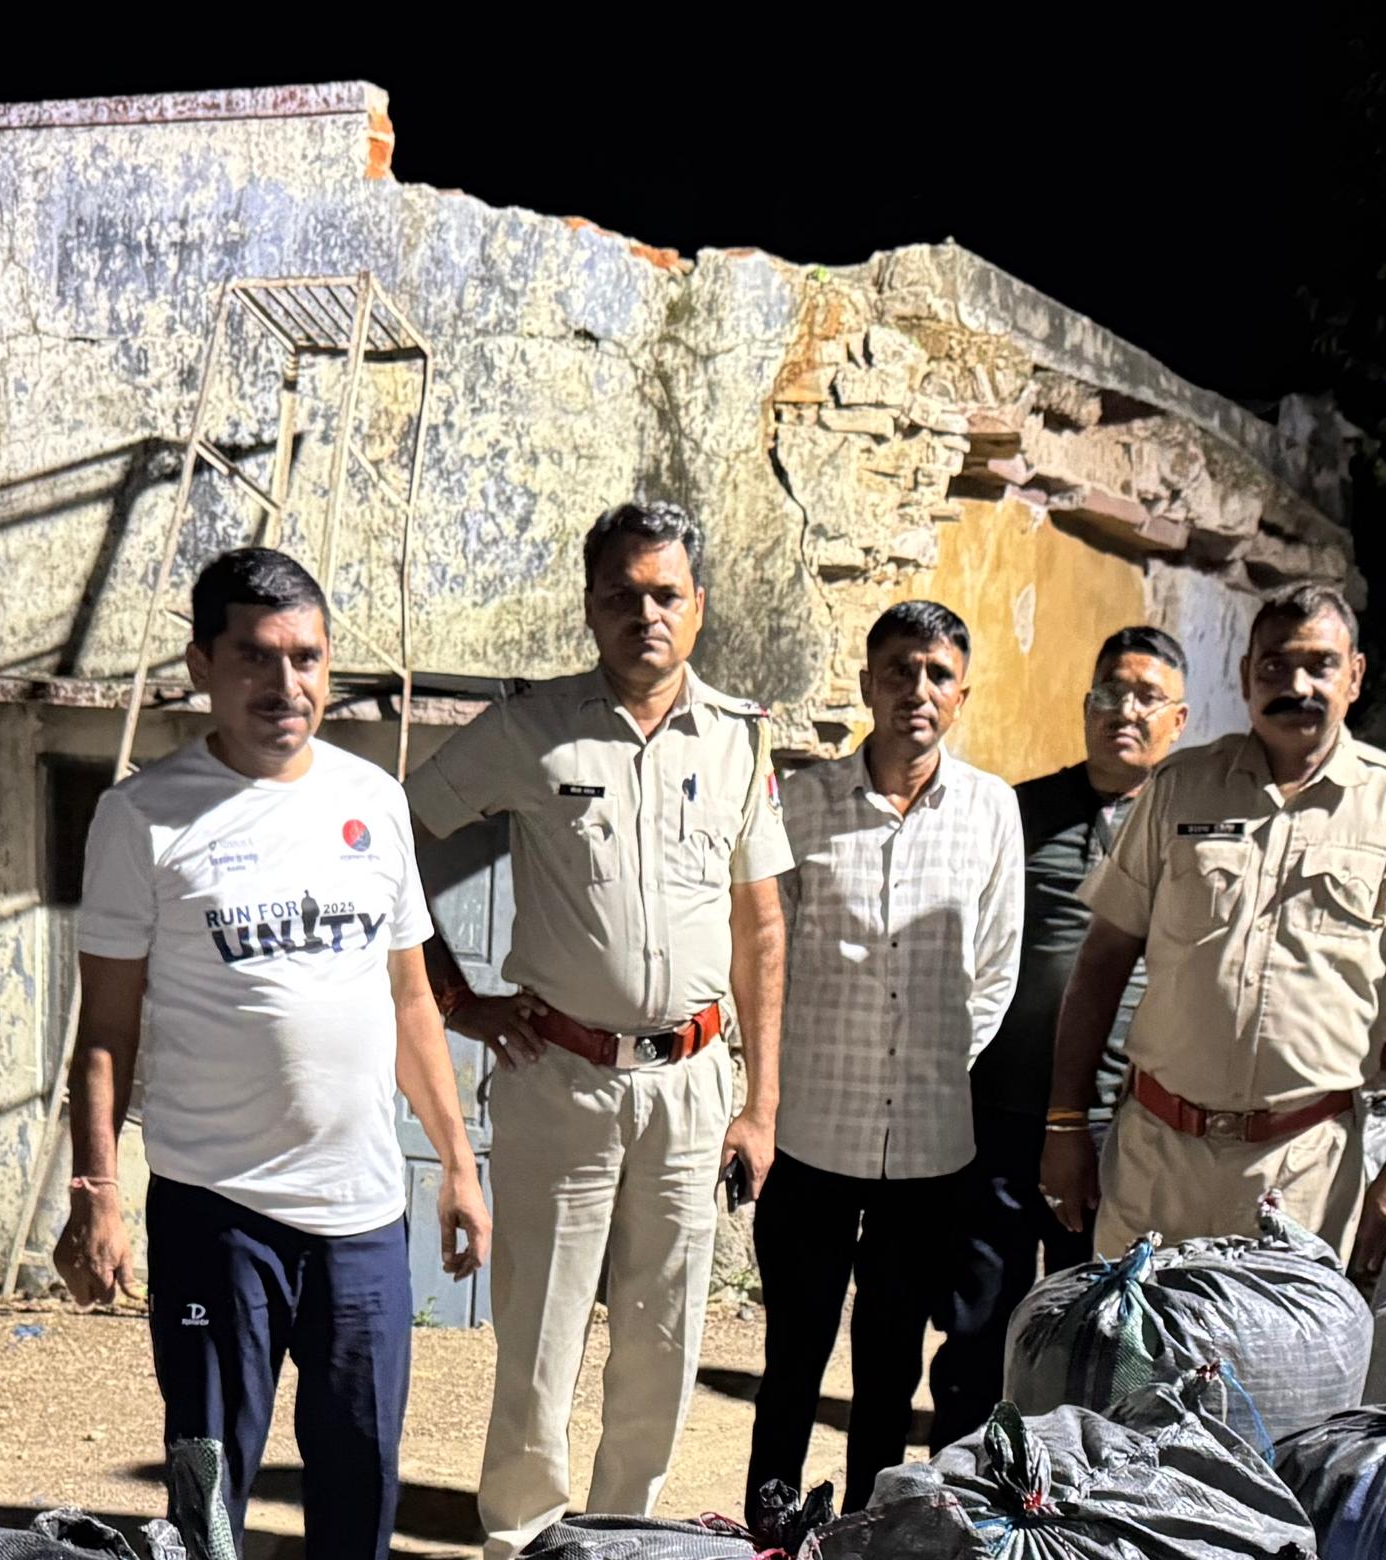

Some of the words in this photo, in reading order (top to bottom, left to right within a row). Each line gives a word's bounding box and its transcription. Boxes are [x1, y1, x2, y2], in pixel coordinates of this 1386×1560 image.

[205, 905, 251, 928] RUN
[258, 901, 300, 920] FOR
[323, 902, 355, 914] 2025
